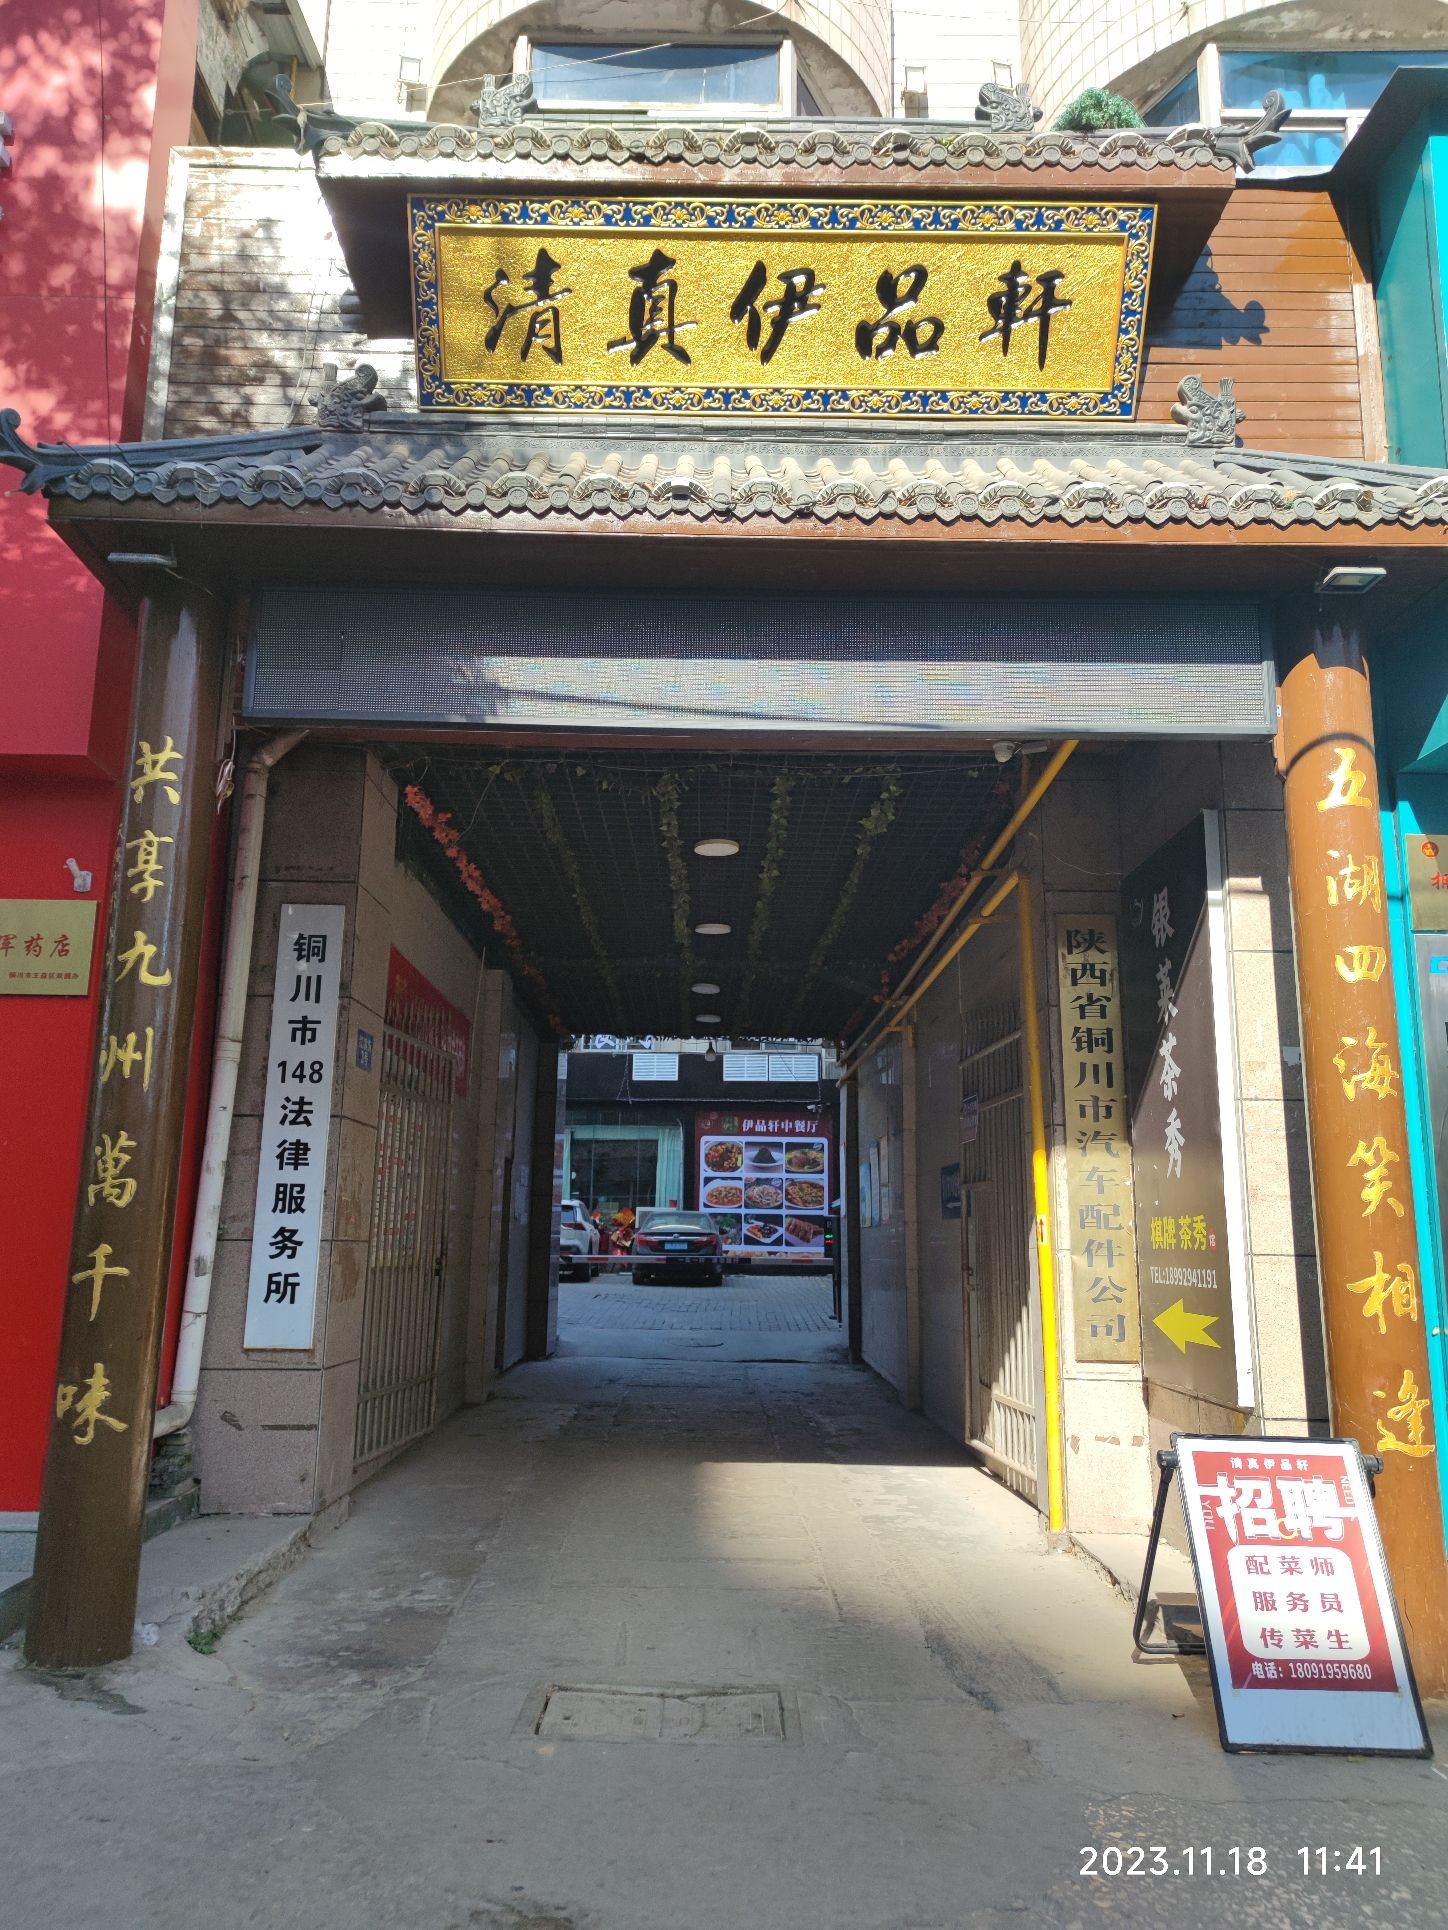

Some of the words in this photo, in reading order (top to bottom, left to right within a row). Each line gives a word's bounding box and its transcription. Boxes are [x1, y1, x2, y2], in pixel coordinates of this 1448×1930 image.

[483, 247, 1073, 371] 清真伊品軒
[57, 735, 183, 1446] 共享九州萬千味
[262, 932, 328, 1305] 铜川市148法律服务所
[1066, 929, 1127, 1343] 陕西省铜川市汽车配件公司
[1315, 746, 1437, 1457] 五湖四海笑相逢
[1197, 1471, 1358, 1547] 招聘
[1244, 1555, 1335, 1577] 配菜师
[1252, 1590, 1344, 1613] 服务员
[1260, 1627, 1352, 1650] 传菜生
